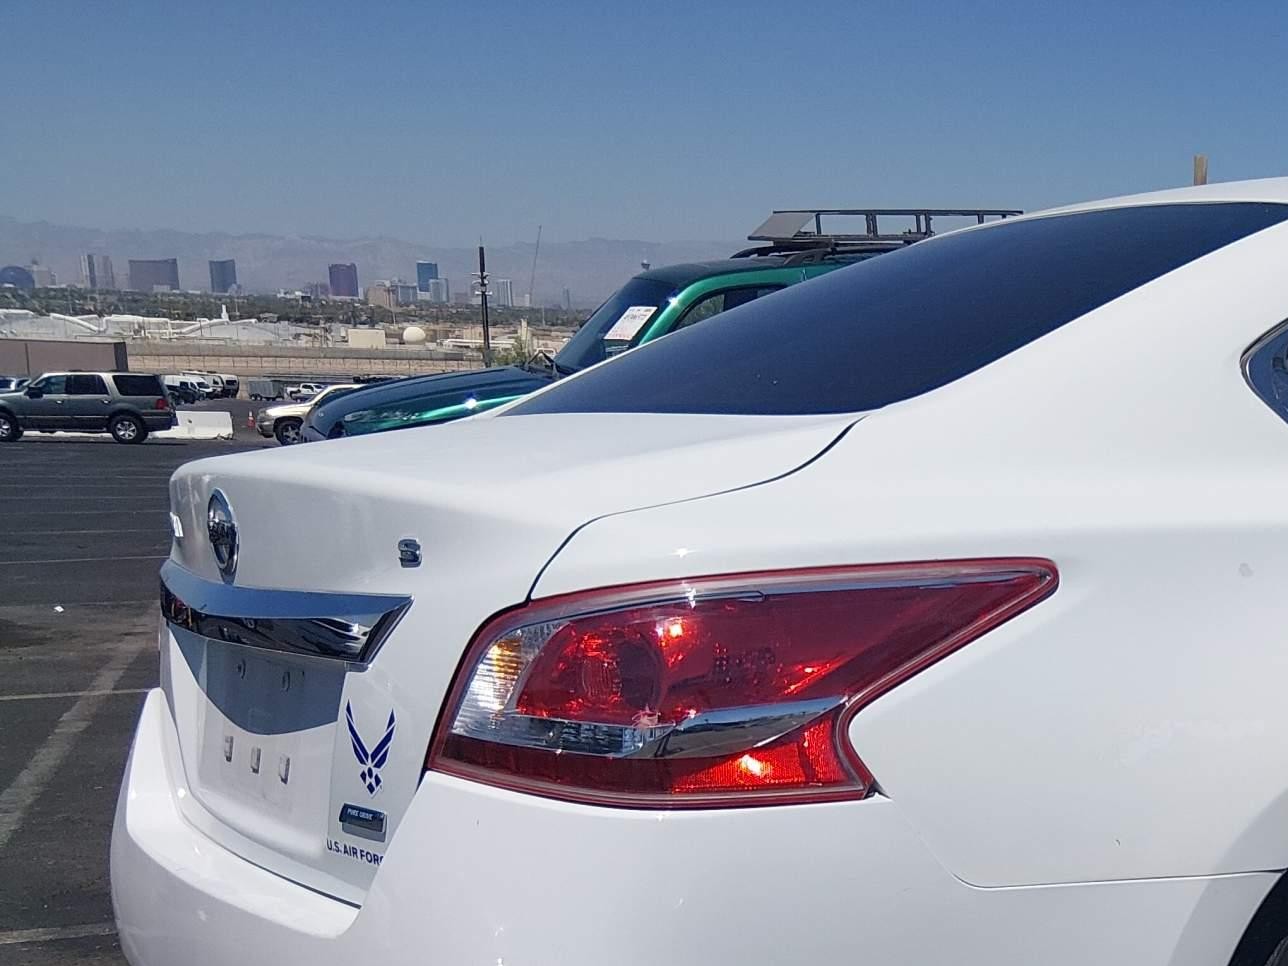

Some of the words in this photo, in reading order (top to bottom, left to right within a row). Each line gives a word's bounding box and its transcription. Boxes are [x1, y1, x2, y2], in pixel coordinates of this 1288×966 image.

[398, 537, 423, 568] S
[326, 838, 342, 853] U.S.
[343, 844, 358, 859] AIR
